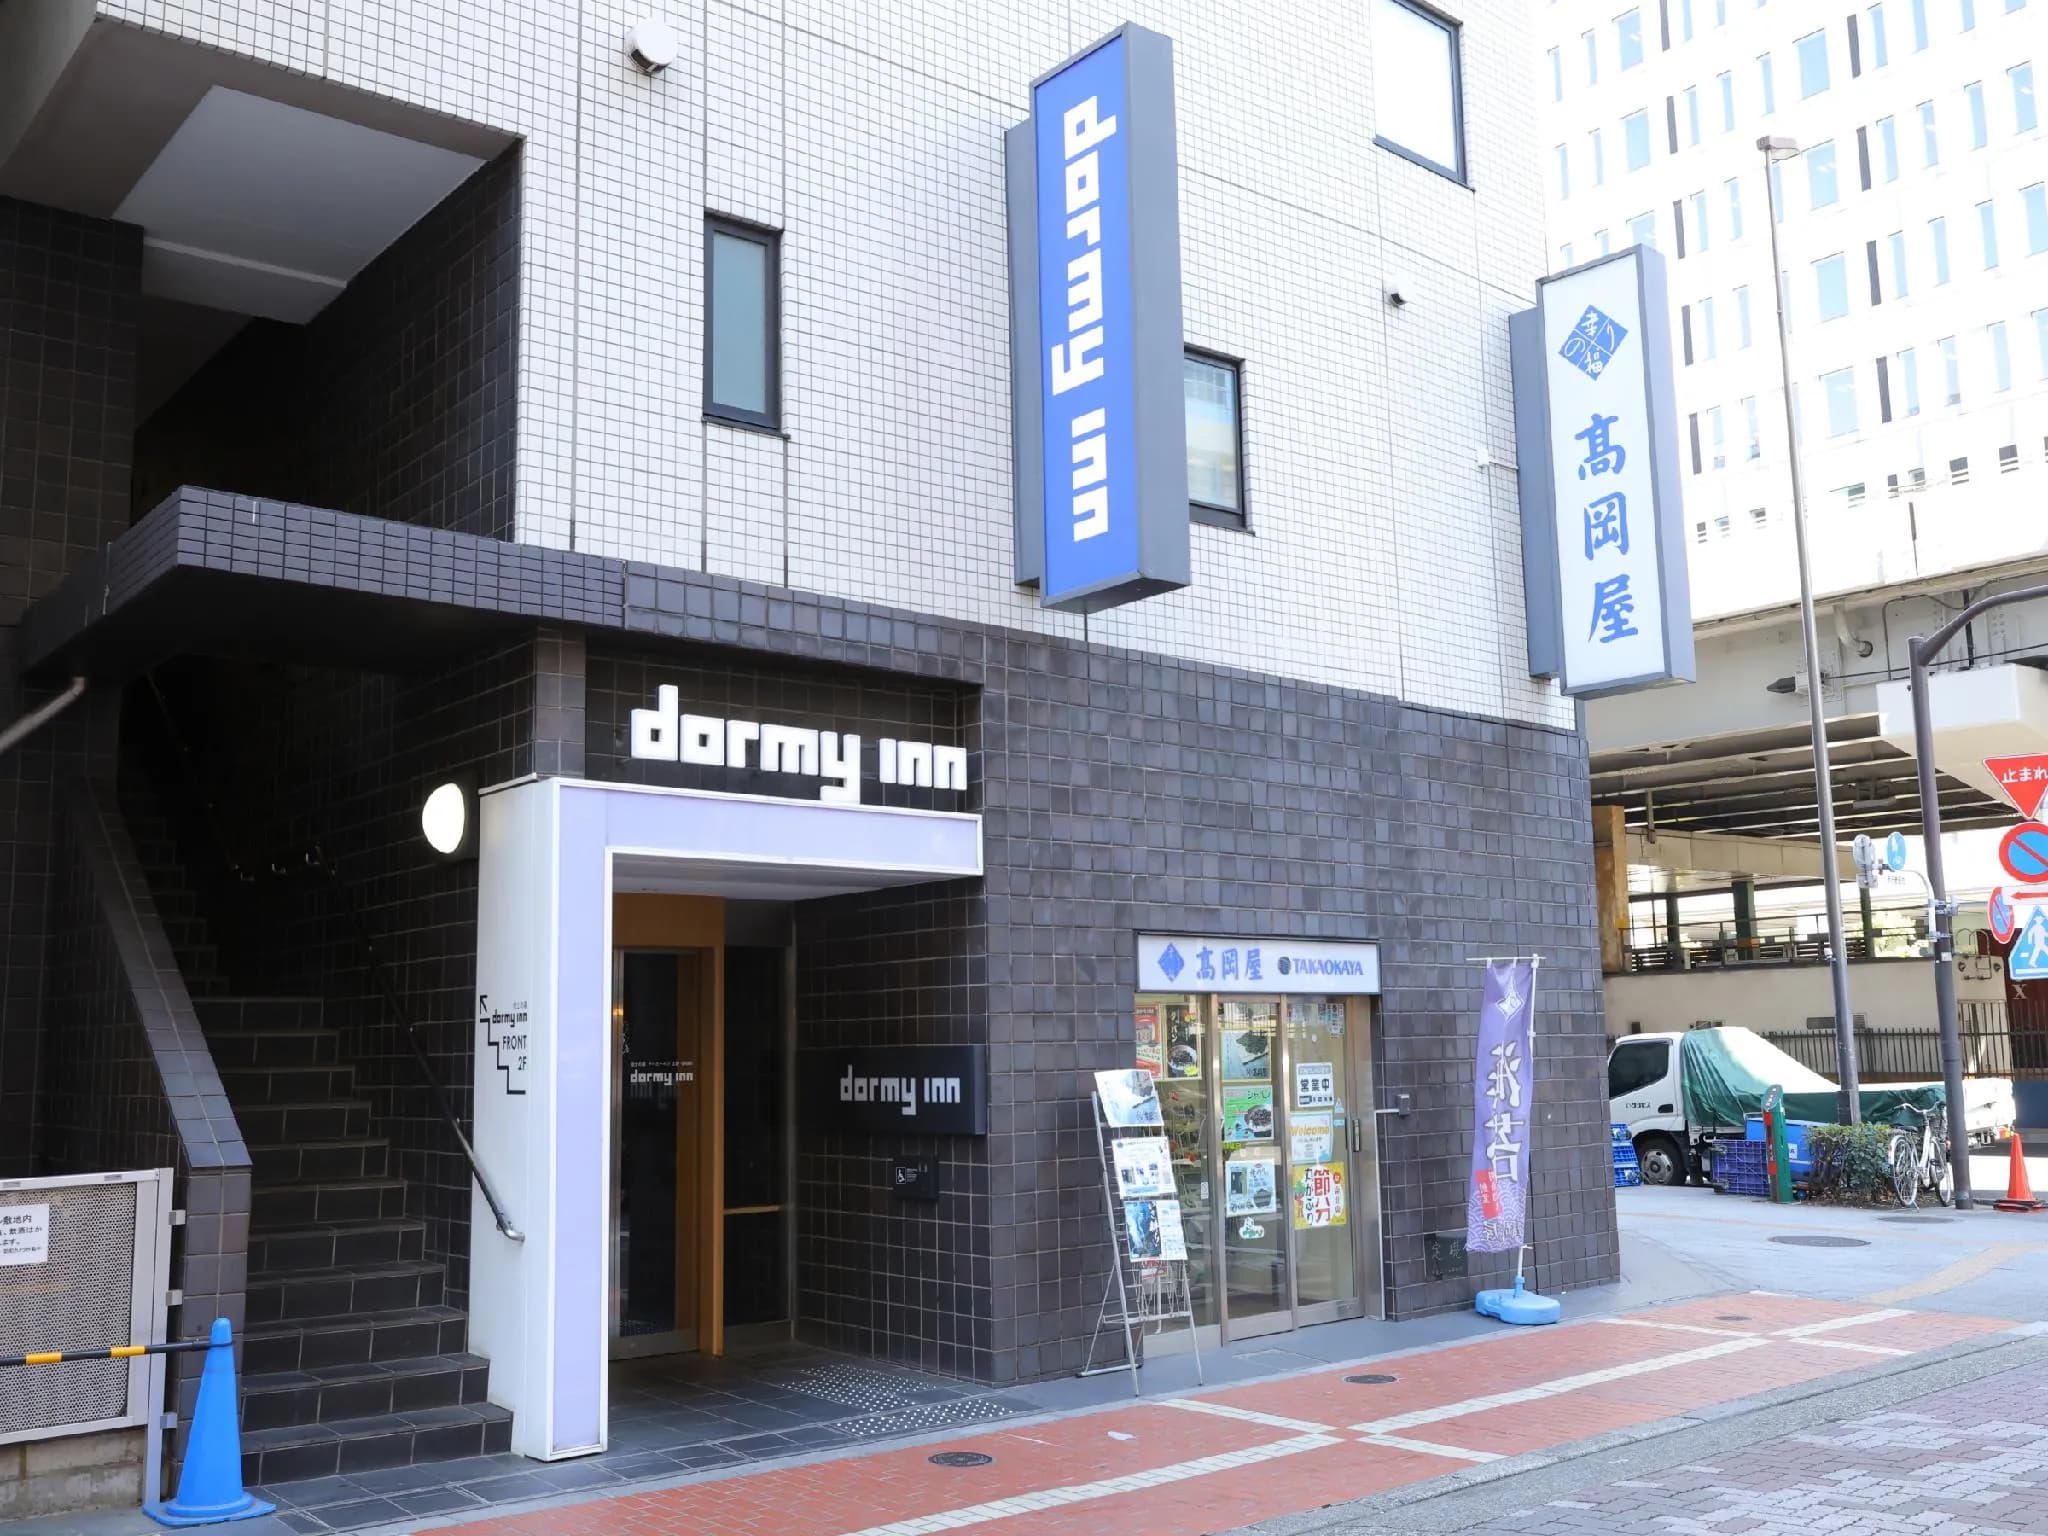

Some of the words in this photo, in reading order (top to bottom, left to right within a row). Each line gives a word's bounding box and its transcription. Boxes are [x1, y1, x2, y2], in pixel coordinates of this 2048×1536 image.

[1051, 95, 1117, 396] dormy
[1071, 408, 1109, 542] inn
[631, 684, 861, 806] dormy
[879, 738, 967, 791] inn
[2001, 766, 2048, 783] 止まれ
[1292, 957, 1364, 976] TAKAOKAYA
[492, 1008, 516, 1028] dormy
[516, 1012, 528, 1022] inn
[502, 1035, 527, 1051] FRONT
[518, 1055, 527, 1070] 2F
[630, 1069, 673, 1086] dormy
[675, 1072, 694, 1081] inn
[1300, 1078, 1330, 1093] 営業中
[840, 1064, 917, 1116] dormy
[923, 1077, 961, 1104] inn
[1290, 1123, 1329, 1137] Welcome
[1314, 1168, 1330, 1223] 節分
[0, 1214, 32, 1226] 敷地内
